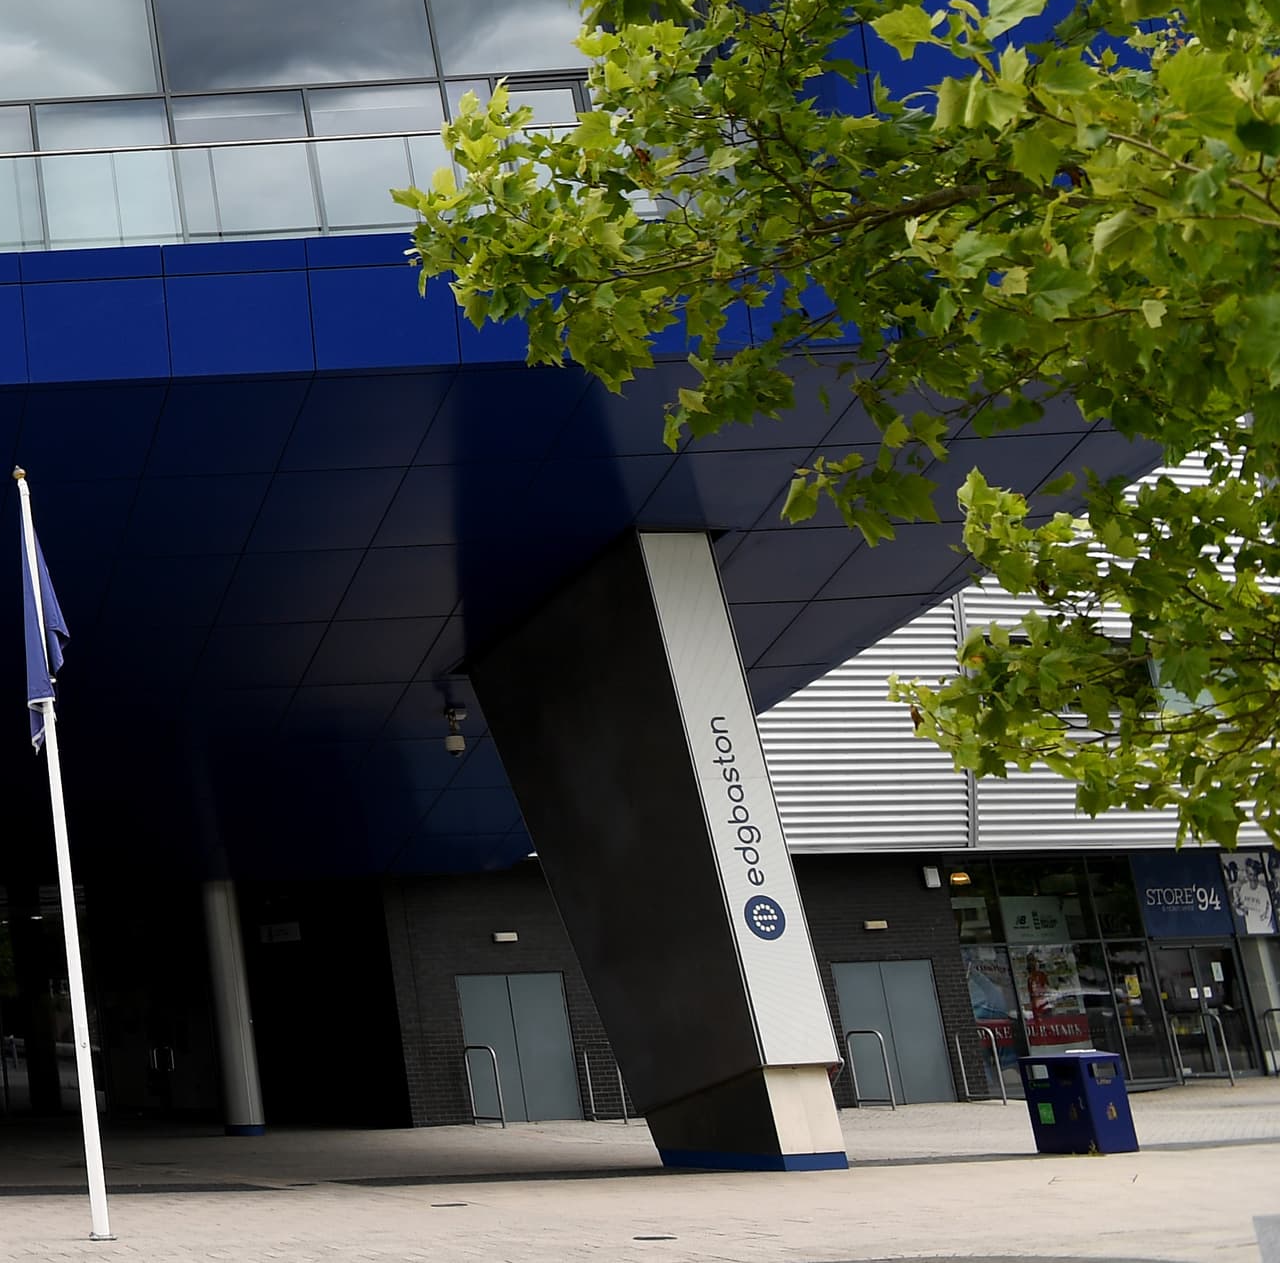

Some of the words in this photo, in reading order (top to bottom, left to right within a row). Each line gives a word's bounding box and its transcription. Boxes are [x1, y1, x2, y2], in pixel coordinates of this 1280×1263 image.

[710, 716, 765, 886] edgbaston
[1145, 888, 1194, 905] STORE
[977, 1026, 1012, 1040] MKE
